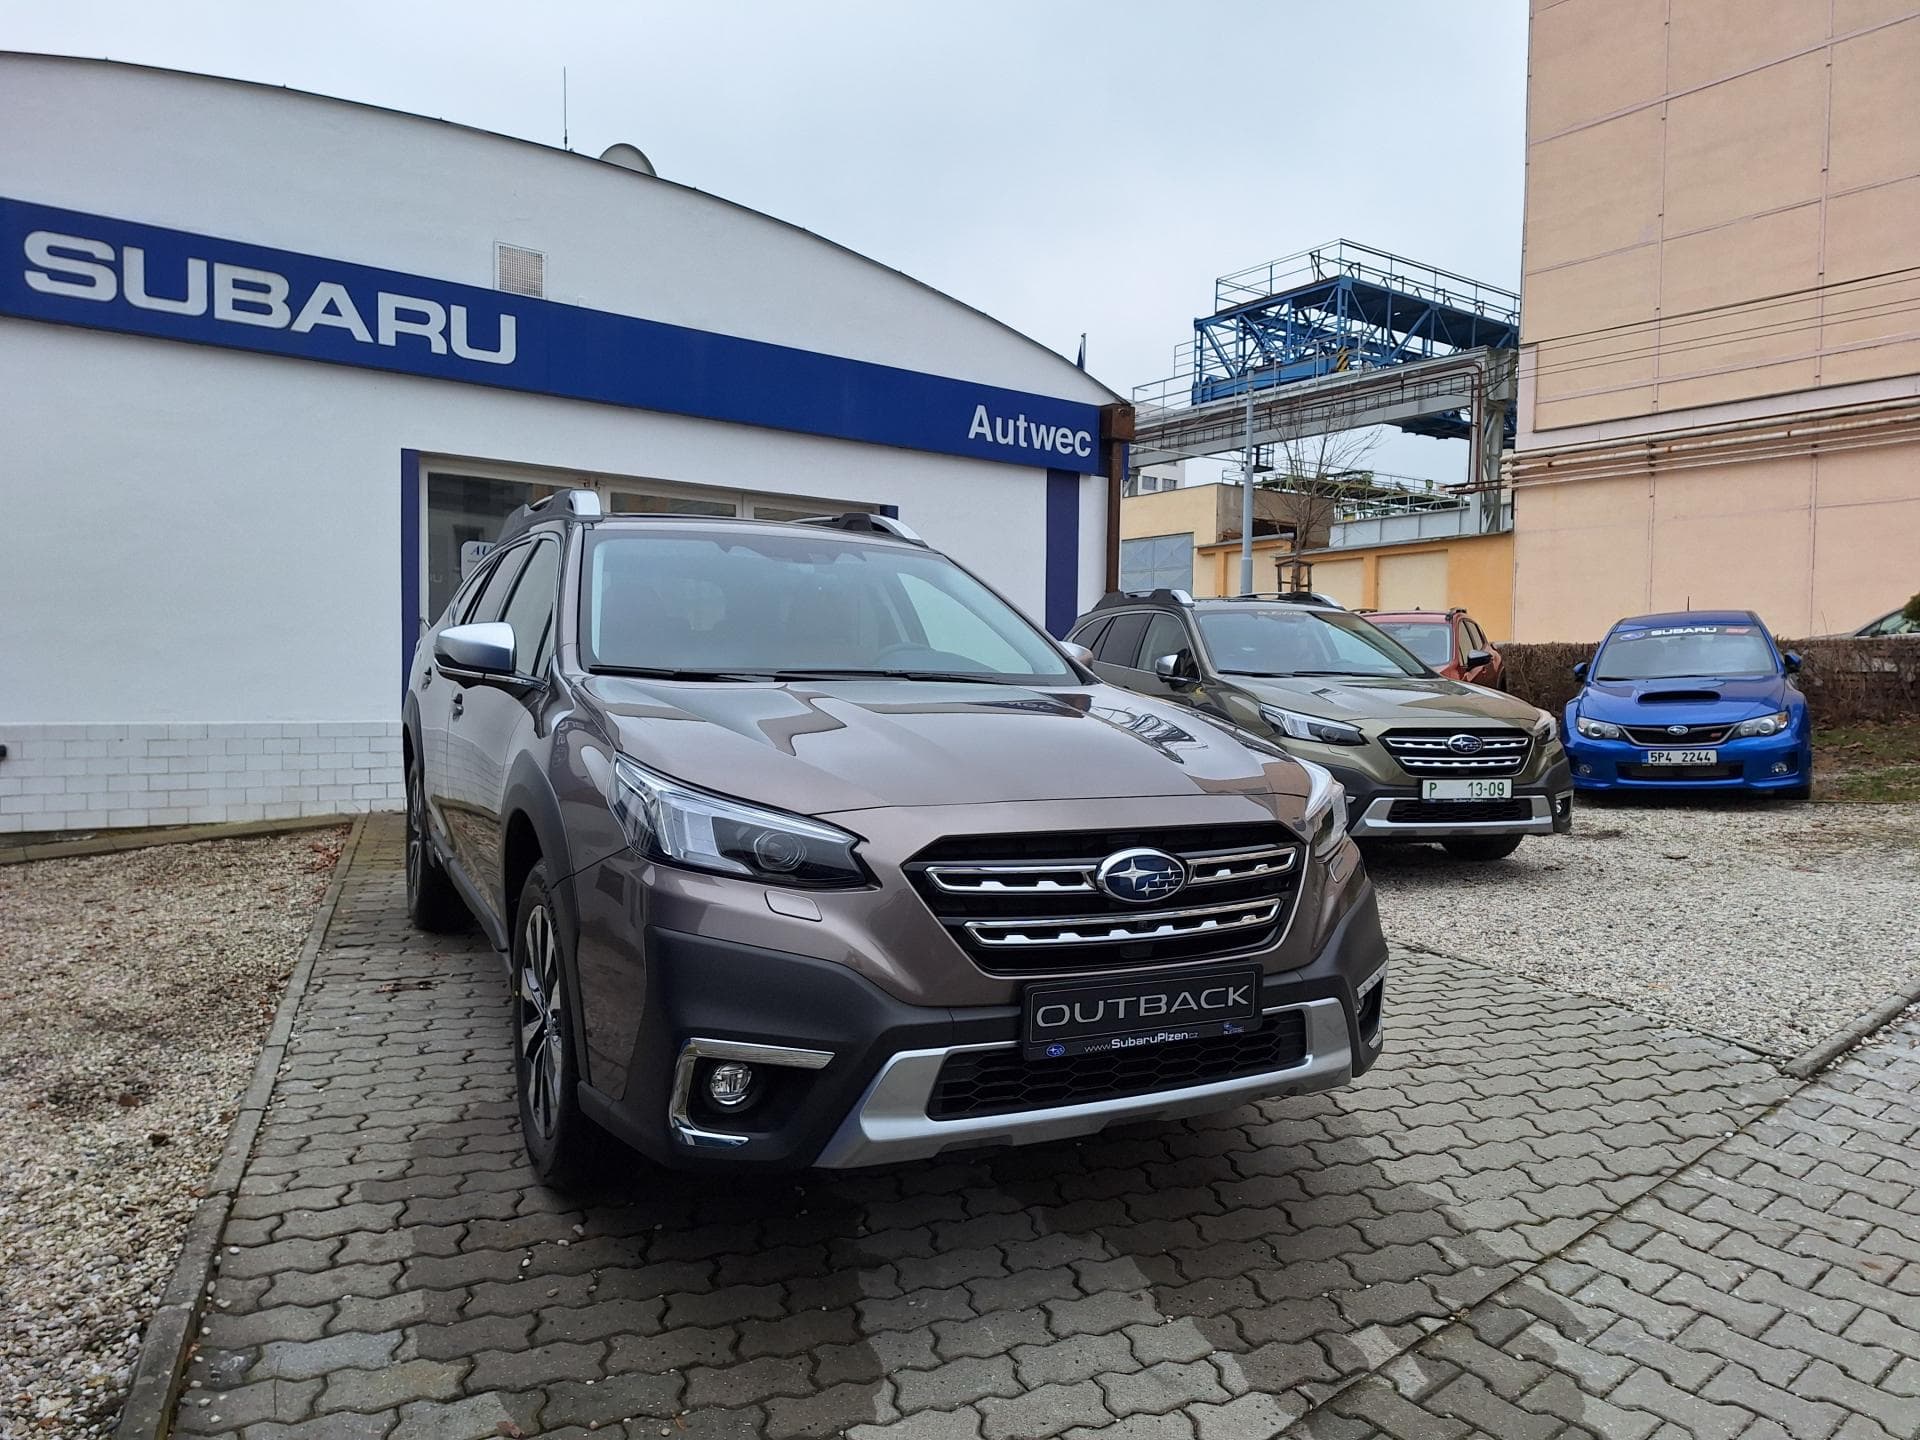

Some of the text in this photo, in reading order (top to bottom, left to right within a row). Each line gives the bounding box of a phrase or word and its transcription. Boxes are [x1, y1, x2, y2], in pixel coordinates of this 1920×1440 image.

[23, 230, 517, 365] SUBARU
[968, 404, 1092, 458] Autwec
[1651, 627, 1717, 636] SUBARU
[1650, 752, 1711, 763] 5P4 2244
[1429, 782, 1505, 798] P 13-09
[1036, 985, 1249, 1027] OUTBACK
